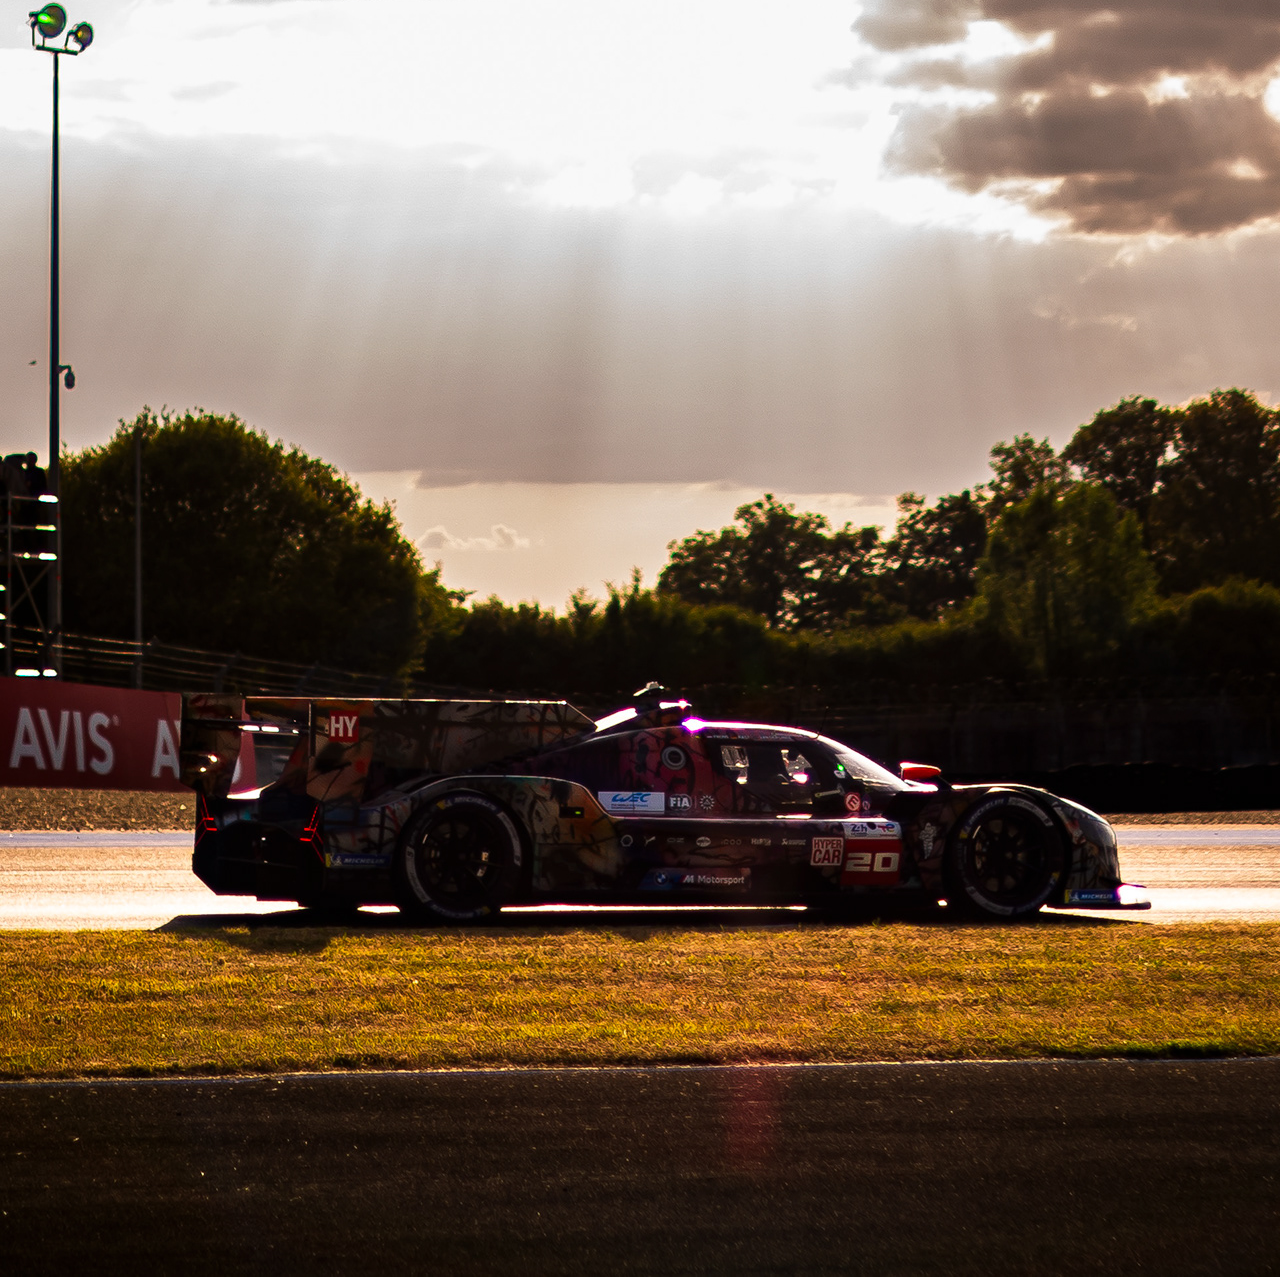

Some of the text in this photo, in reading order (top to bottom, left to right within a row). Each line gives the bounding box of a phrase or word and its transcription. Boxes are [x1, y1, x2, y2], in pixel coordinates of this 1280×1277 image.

[330, 715, 358, 738] HY
[12, 707, 114, 774] AVIS
[611, 792, 651, 803] WEC
[813, 839, 842, 849] HYPER
[813, 850, 841, 864] CAR
[845, 852, 900, 872] 20
[697, 874, 745, 885] Motorsport
